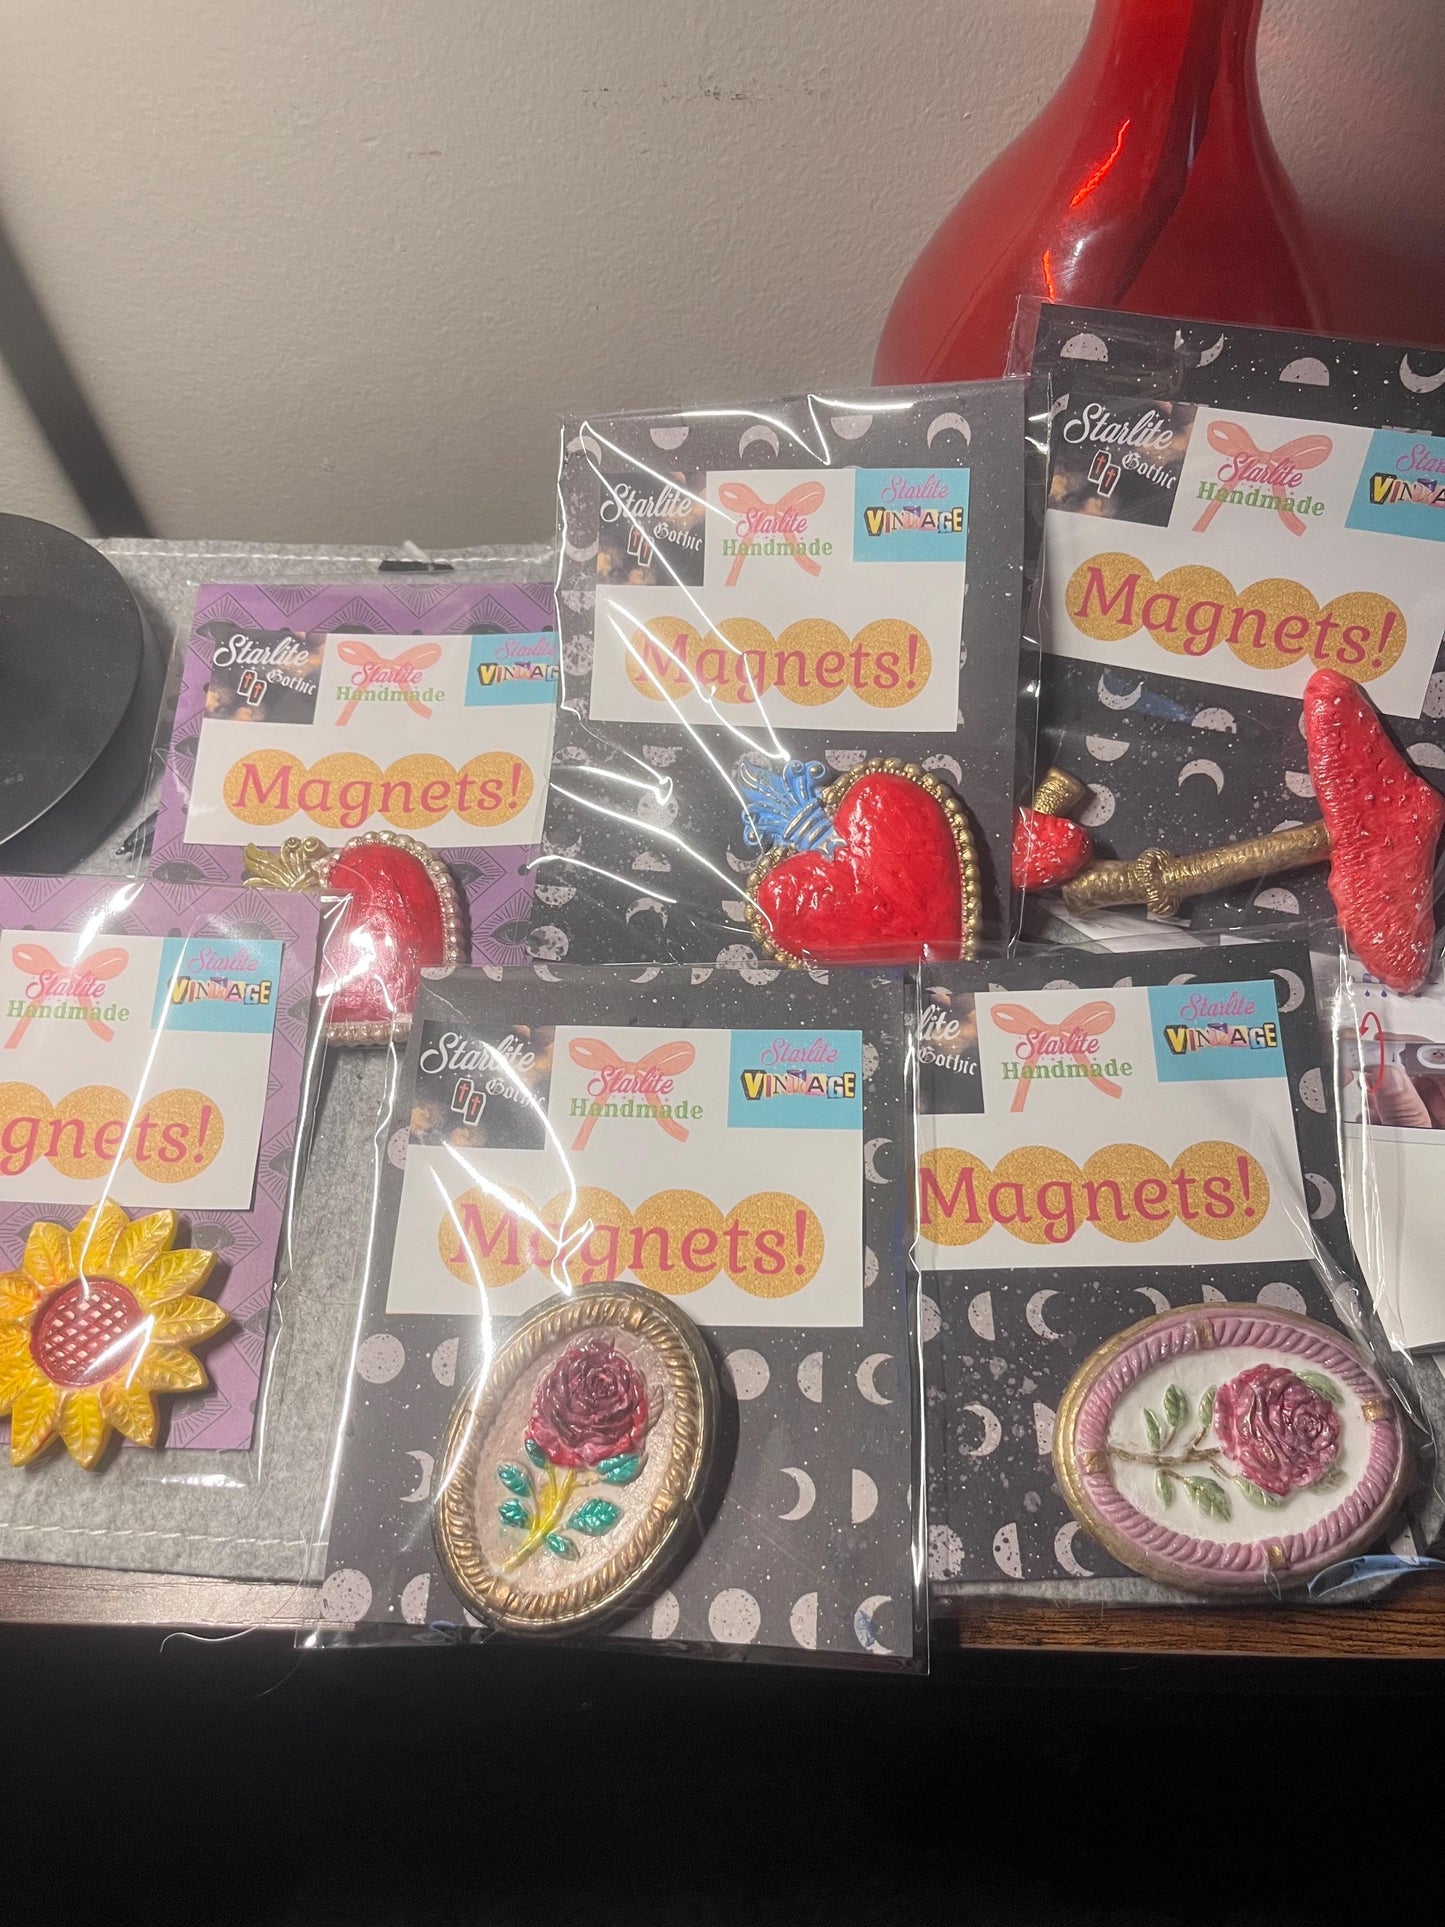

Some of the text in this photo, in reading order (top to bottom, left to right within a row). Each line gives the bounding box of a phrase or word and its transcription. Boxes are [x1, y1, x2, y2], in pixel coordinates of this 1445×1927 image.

[1063, 403, 1174, 450] Starlite
[1121, 452, 1177, 490] Gothic
[1217, 451, 1303, 488] Starlite
[1395, 444, 1445, 474] Star
[600, 483, 693, 522] Starlite
[881, 474, 949, 503] Starlite
[1196, 481, 1325, 516] Handmade
[735, 506, 807, 538] Starlite
[864, 506, 963, 536] VINTAGE
[653, 522, 703, 552] Gothic
[721, 538, 832, 556] Handmade
[1074, 566, 1397, 668] Magnets!
[213, 633, 310, 667] Starlite
[266, 670, 317, 696] Gothic
[350, 661, 423, 686] Starlite
[477, 663, 560, 686] VINTAG
[634, 633, 918, 703] Magnets!
[335, 685, 445, 703] Handmade
[234, 762, 523, 829] Magnets!
[188, 946, 259, 973] Starlite
[25, 969, 106, 999] Starlite
[6, 1000, 129, 1021] Handmade
[1179, 991, 1256, 1022] Starlite
[916, 1004, 960, 1041] lite
[420, 1032, 535, 1074] Starlite
[761, 1037, 839, 1065] Starlite
[1015, 1027, 1100, 1060] Starlite
[1163, 1022, 1278, 1056] VINTAGE
[917, 1045, 977, 1076] Gothic
[1001, 1058, 1133, 1080] Handmade
[587, 1064, 675, 1096] Starlite
[741, 1070, 856, 1100] VINTAGE
[568, 1097, 704, 1120] Handmade
[0, 1105, 212, 1176] gnets!
[919, 1155, 1255, 1244] Magnets!
[449, 1203, 808, 1282] Magnets!
